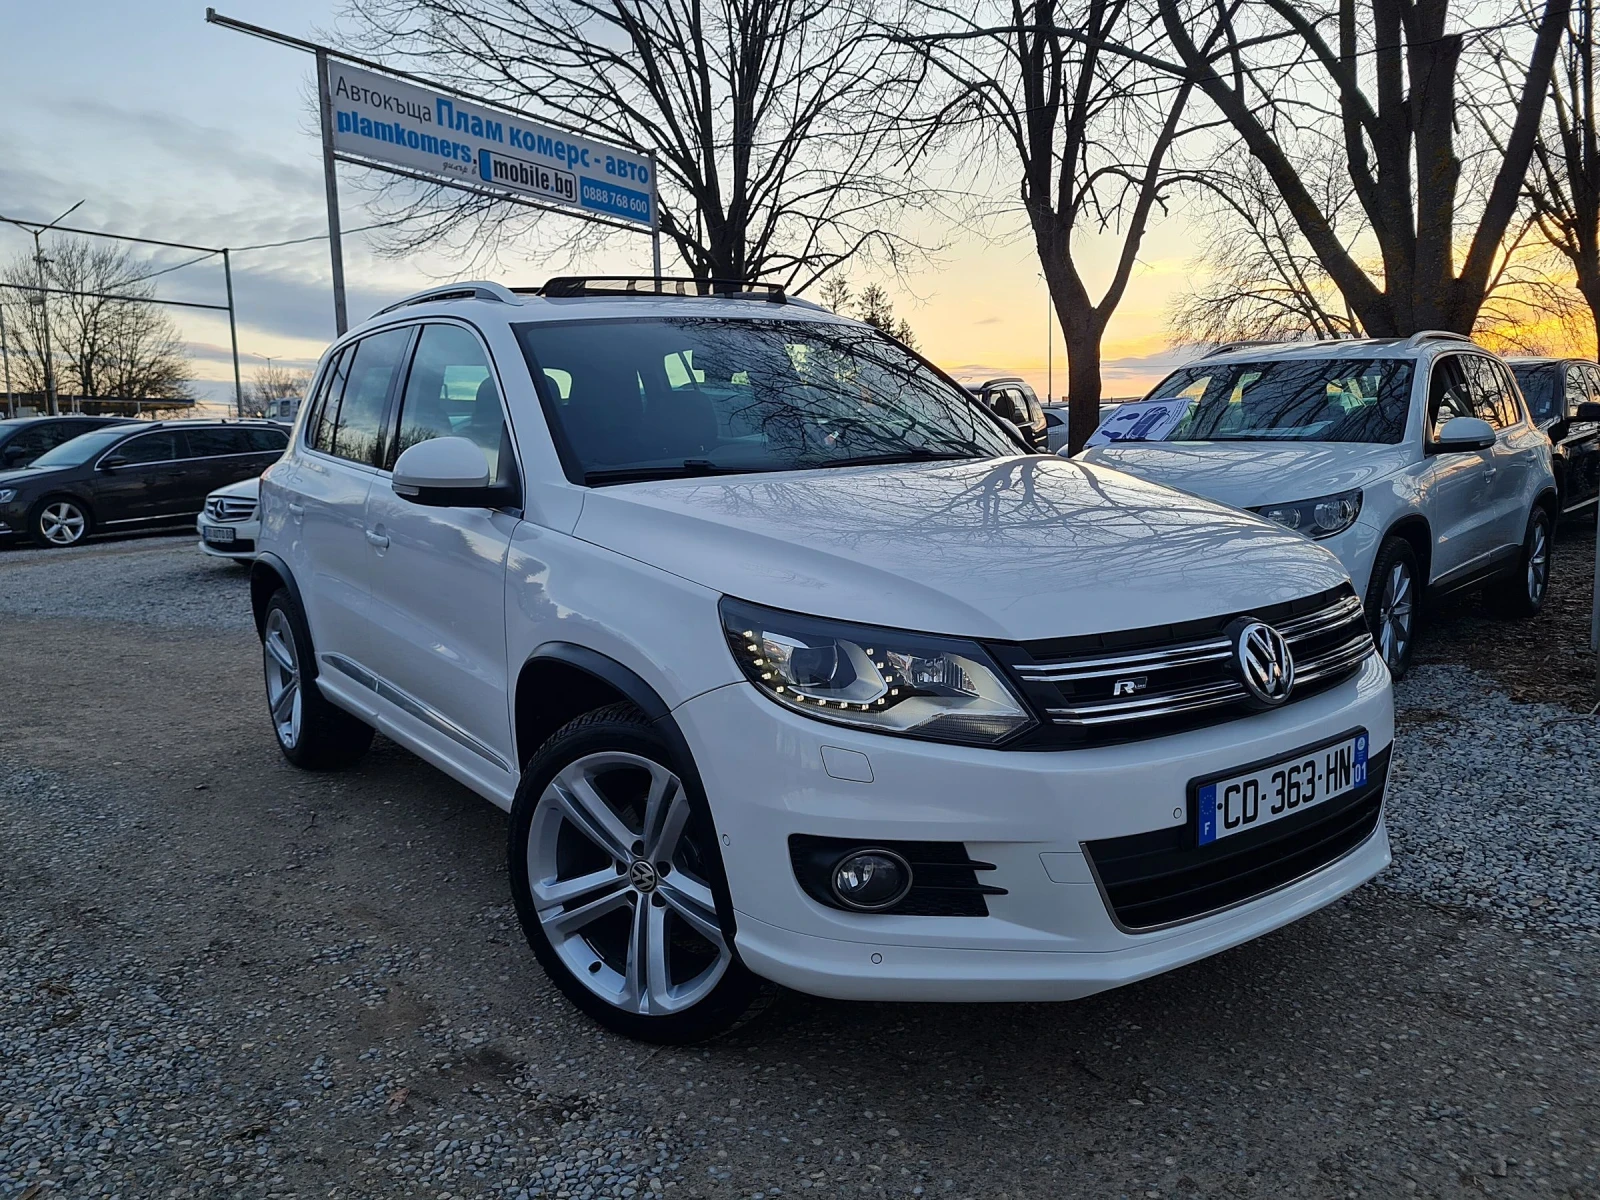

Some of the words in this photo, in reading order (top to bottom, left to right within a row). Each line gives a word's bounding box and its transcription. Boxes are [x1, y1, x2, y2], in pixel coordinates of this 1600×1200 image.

[336, 76, 432, 124] Автокъща
[436, 98, 503, 143] Плам
[509, 126, 590, 170] комерс
[605, 155, 649, 184] авто
[493, 159, 573, 199] mobile.bg
[583, 185, 609, 204] 0888
[610, 192, 629, 209] 768
[630, 198, 648, 214] 600
[1355, 761, 1367, 783] 01
[1204, 821, 1211, 835] F
